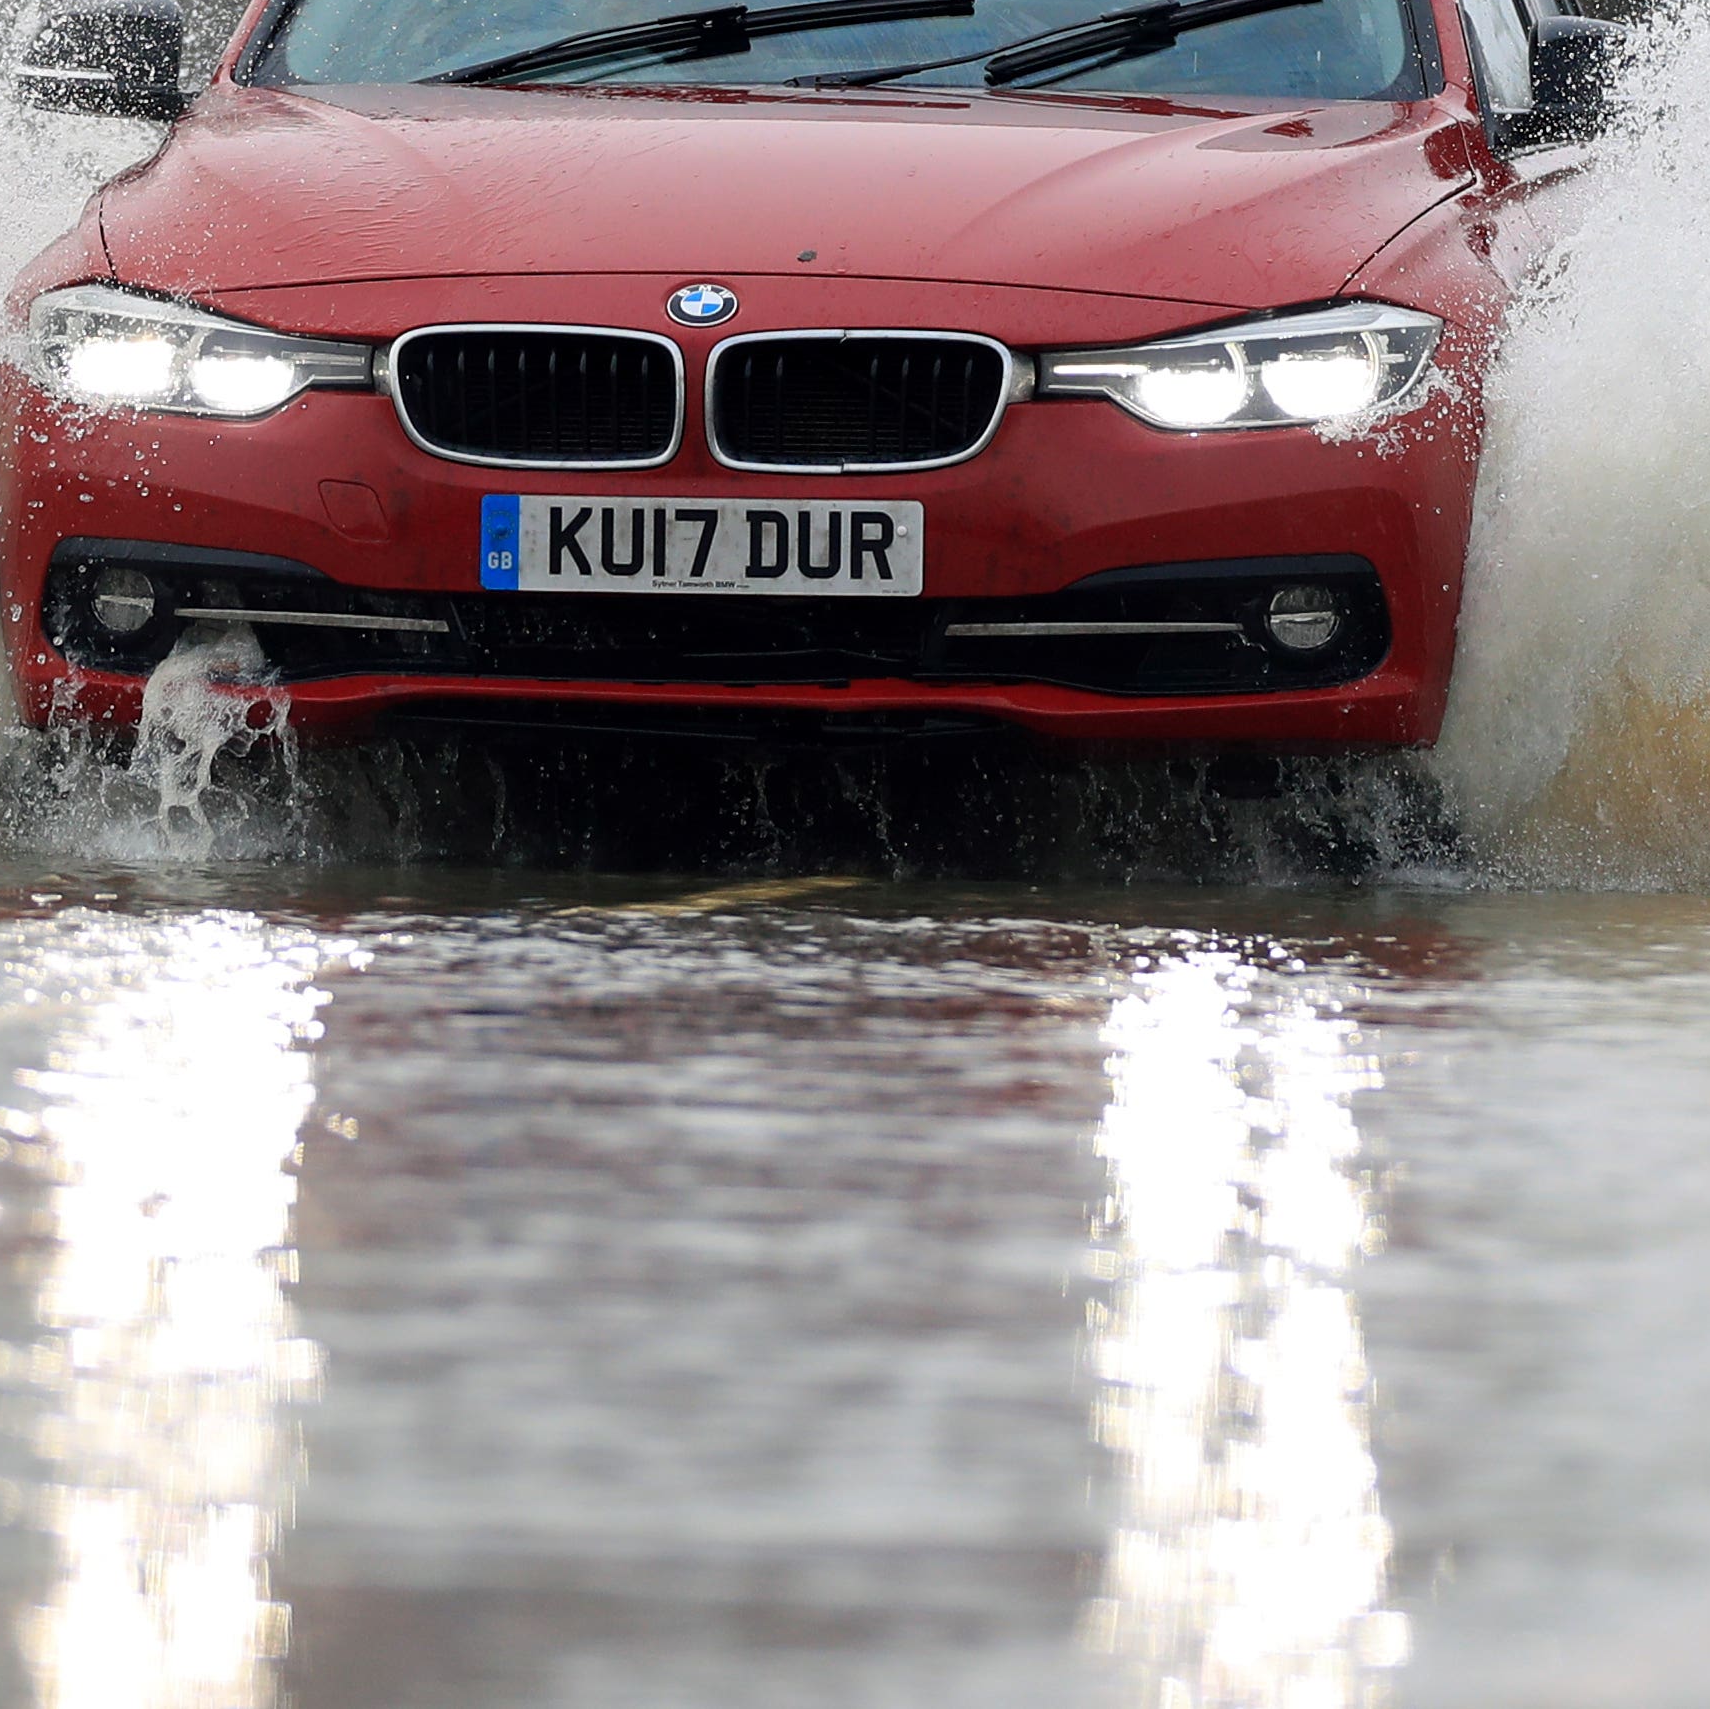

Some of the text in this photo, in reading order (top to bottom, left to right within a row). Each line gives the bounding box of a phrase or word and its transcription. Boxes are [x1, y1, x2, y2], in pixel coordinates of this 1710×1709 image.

[677, 284, 732, 299] BMW
[549, 506, 894, 580] KU17 DUR
[488, 551, 513, 570] GB
[715, 580, 736, 588] BMW
